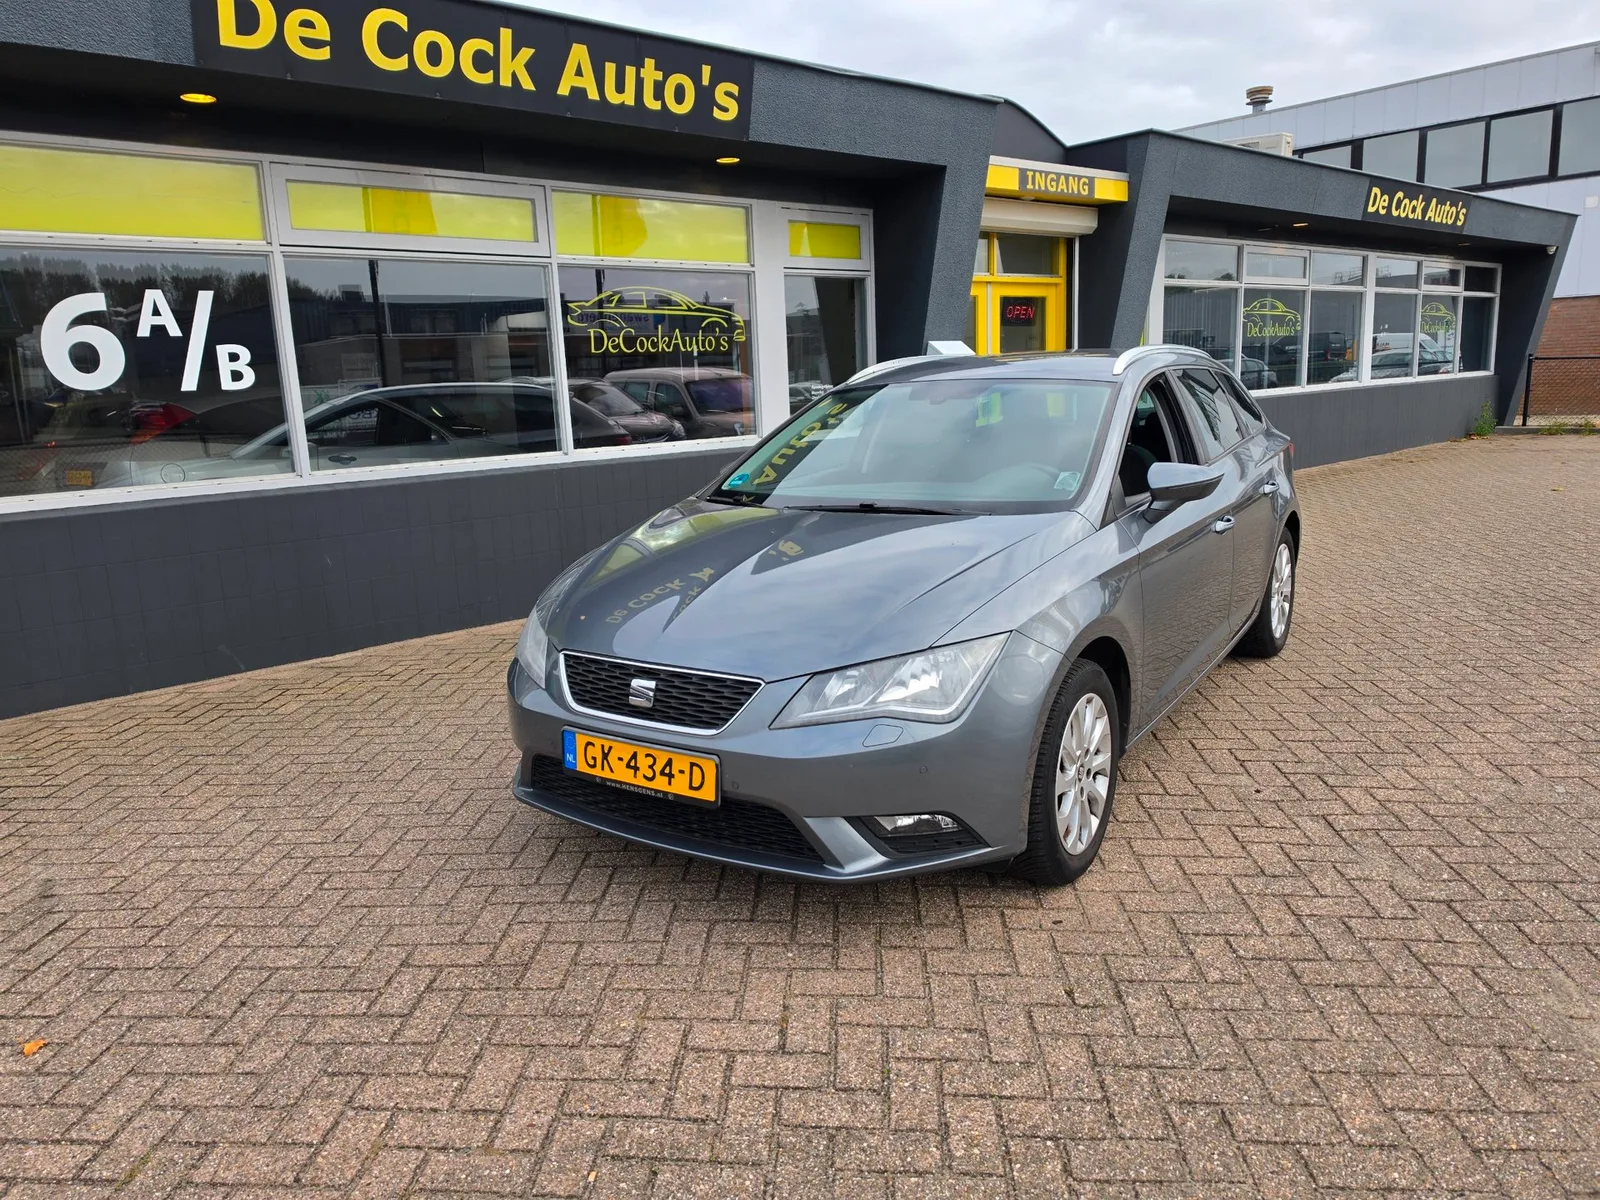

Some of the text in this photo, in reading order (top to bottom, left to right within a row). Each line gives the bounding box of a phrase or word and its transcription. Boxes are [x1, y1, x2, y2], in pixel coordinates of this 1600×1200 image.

[217, 0, 739, 121] De Cock Auto's
[1026, 171, 1089, 195] INGANG
[1367, 186, 1467, 226] De Cock Auto's
[1006, 306, 1035, 319] OPEN
[587, 325, 728, 354] DeCockAuto's
[566, 753, 576, 763] NL
[583, 741, 706, 791] GK-434-D
